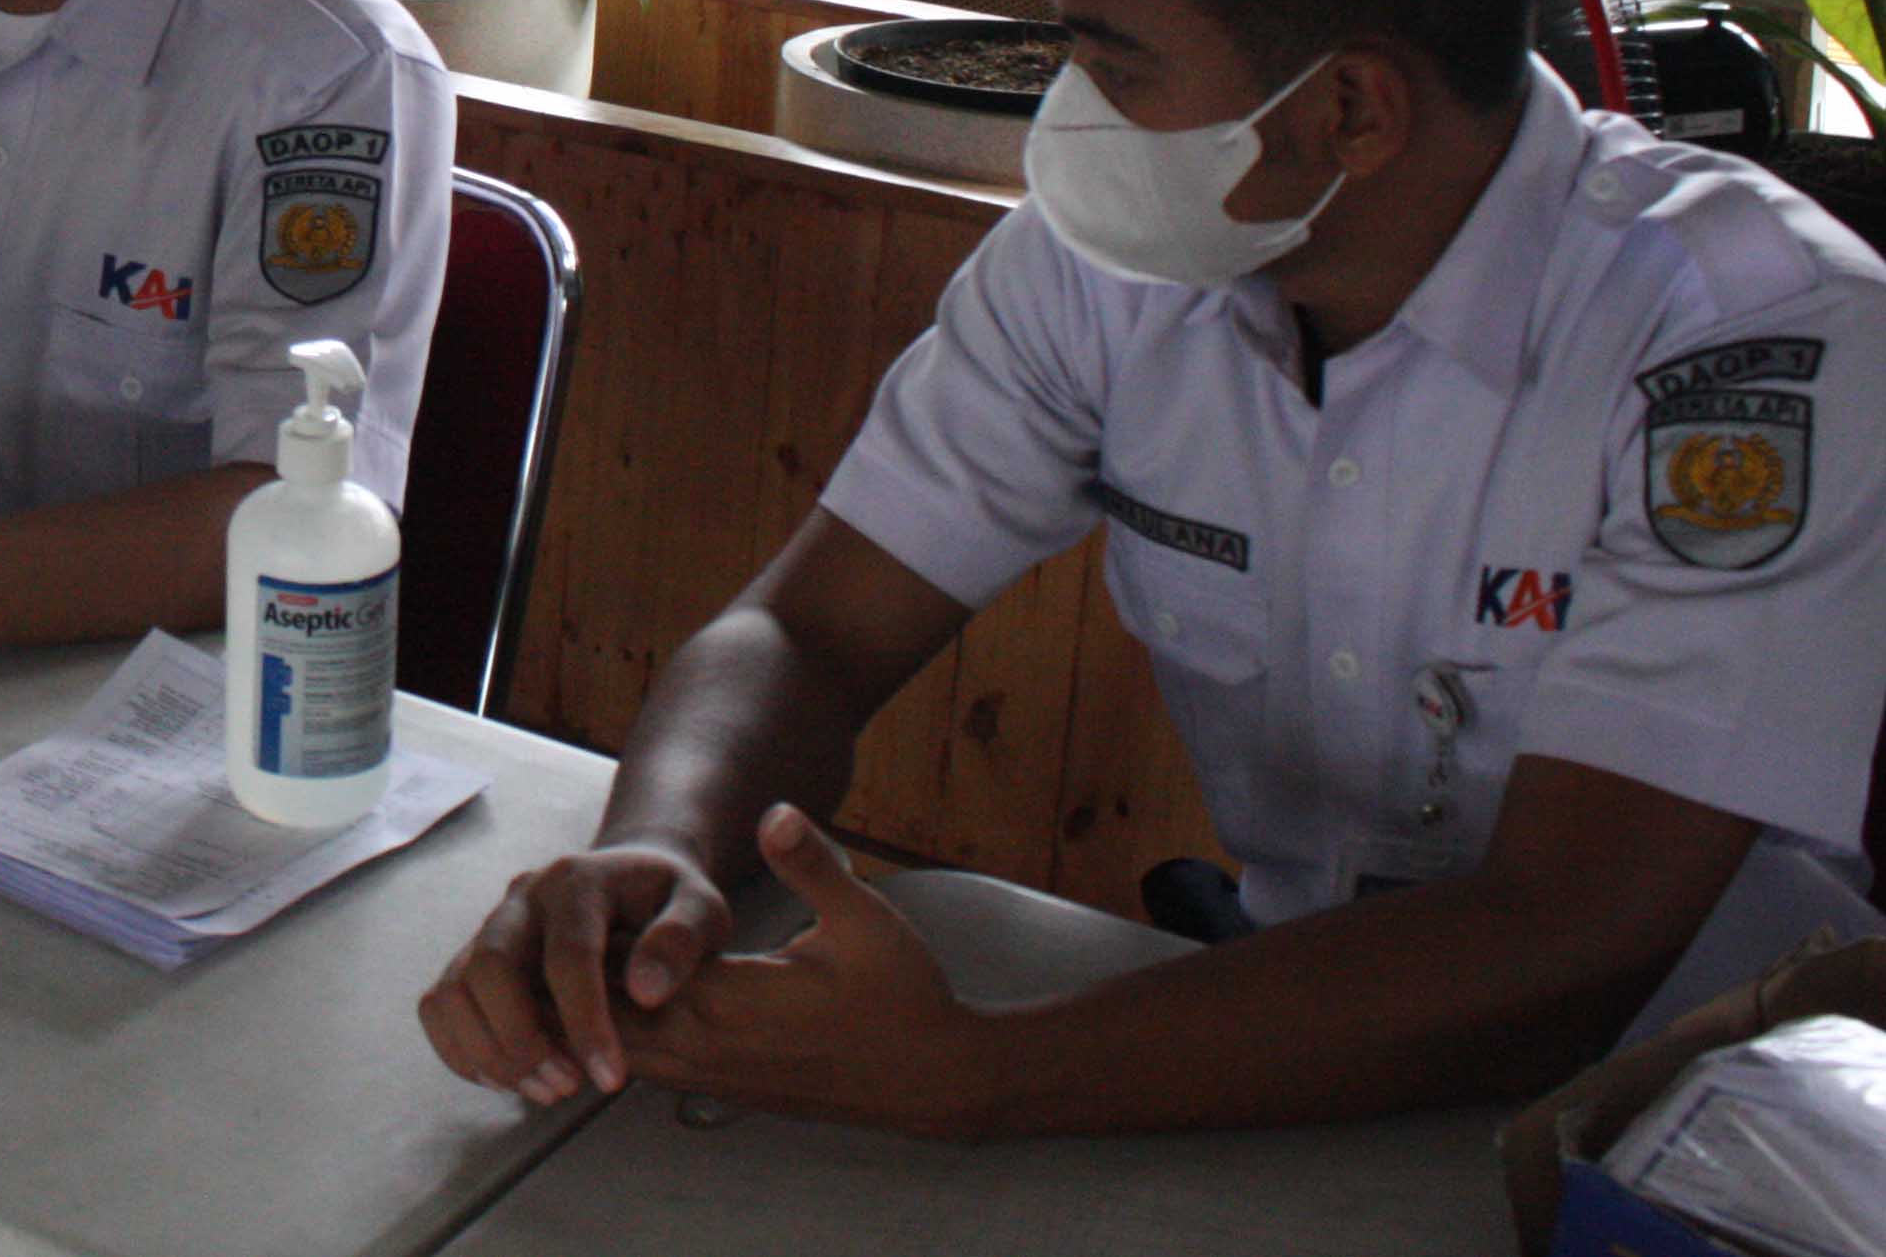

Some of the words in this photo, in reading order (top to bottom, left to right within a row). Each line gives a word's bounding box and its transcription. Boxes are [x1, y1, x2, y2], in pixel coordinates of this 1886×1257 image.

[269, 131, 355, 157] DAOP
[366, 138, 377, 155] 1
[99, 252, 193, 320] KAI
[1658, 347, 1771, 397] DAOP
[1790, 348, 1805, 369] 1
[264, 601, 354, 637] Aseptic
[1476, 564, 1573, 631] KAI
